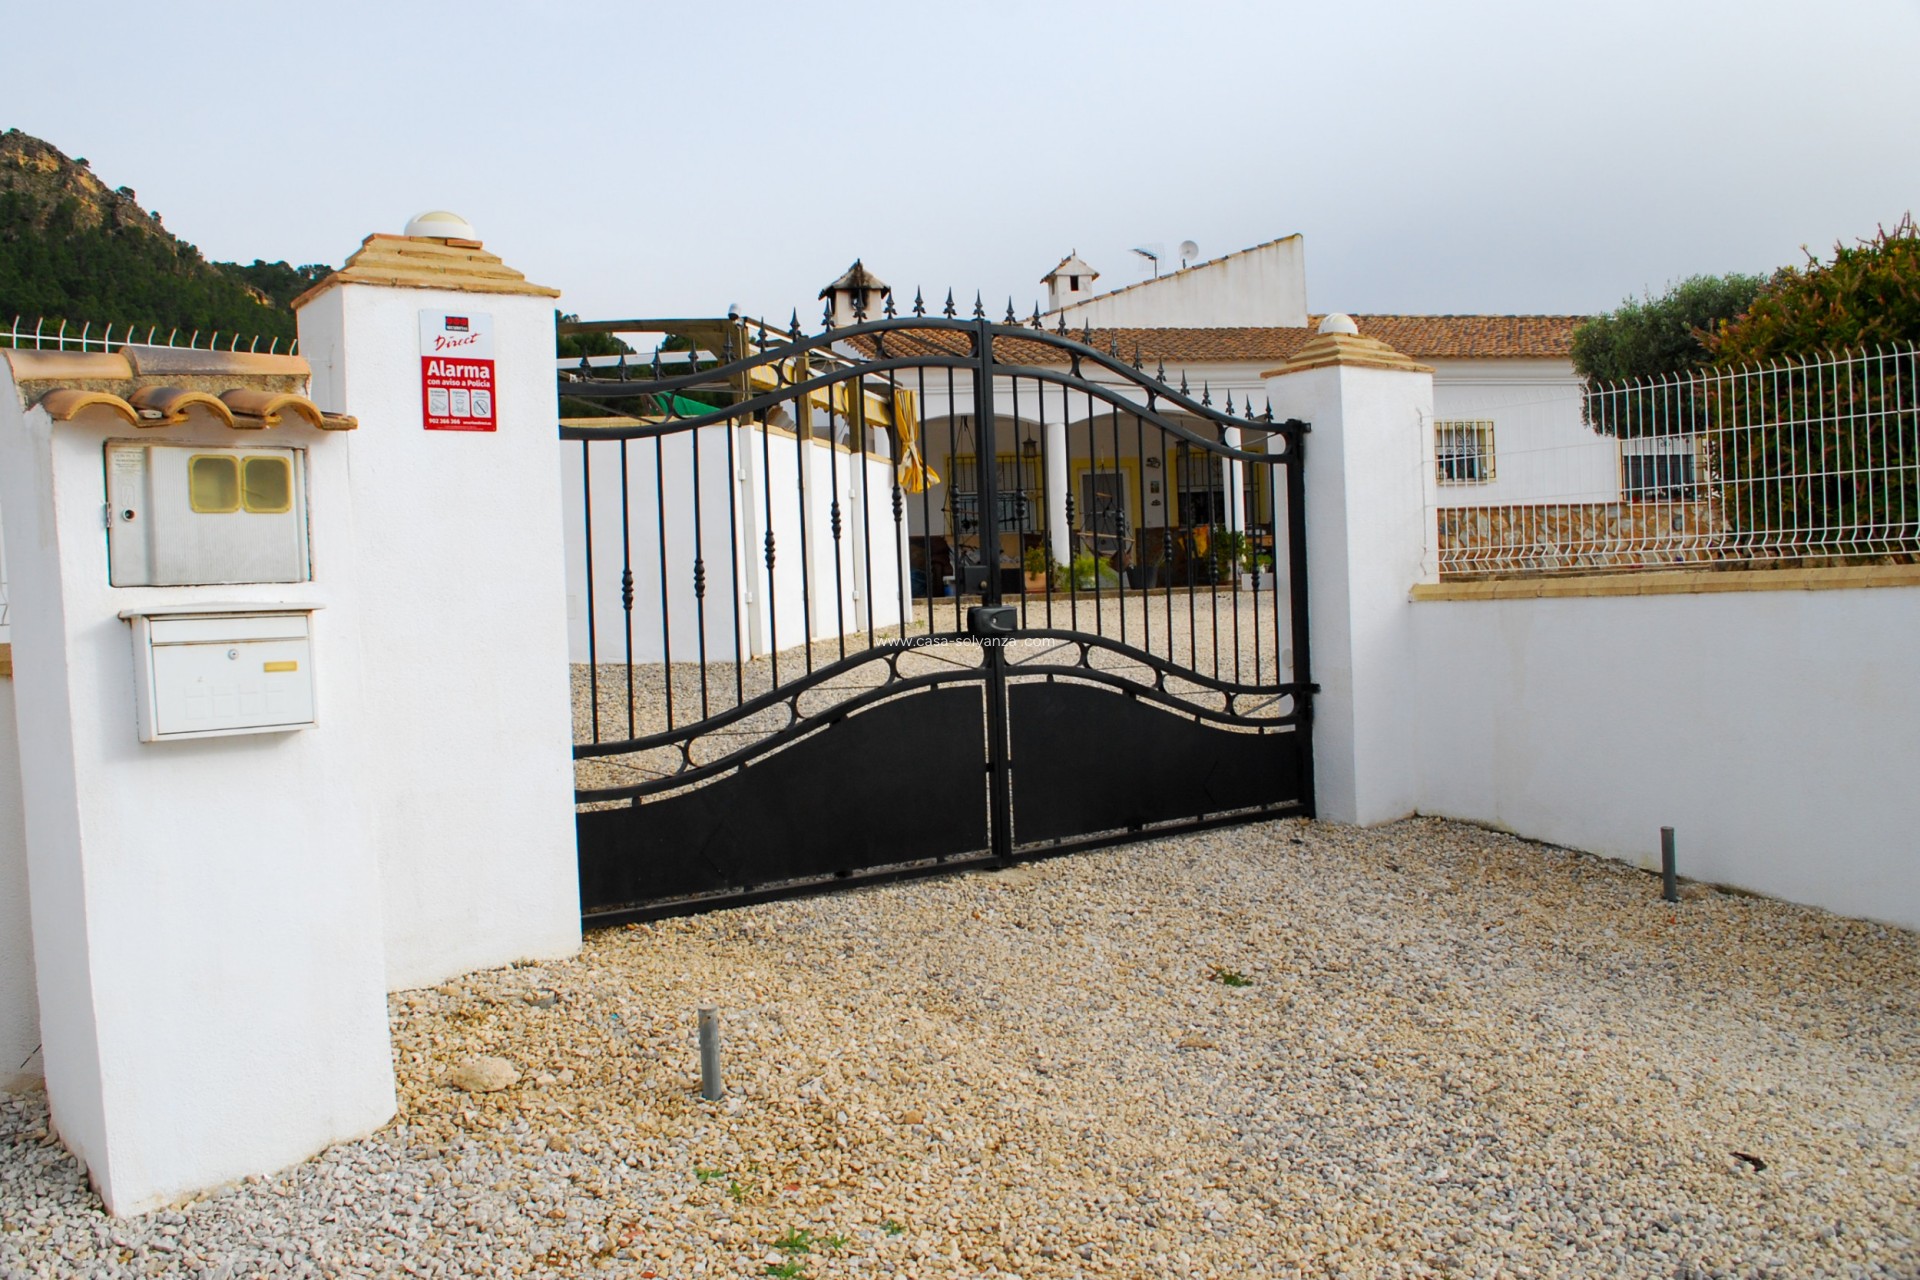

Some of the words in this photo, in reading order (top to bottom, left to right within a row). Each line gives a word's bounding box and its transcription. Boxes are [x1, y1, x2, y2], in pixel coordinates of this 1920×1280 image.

[434, 333, 482, 351] Direct
[427, 360, 490, 379] Alarma
[442, 378, 461, 387] aviso
